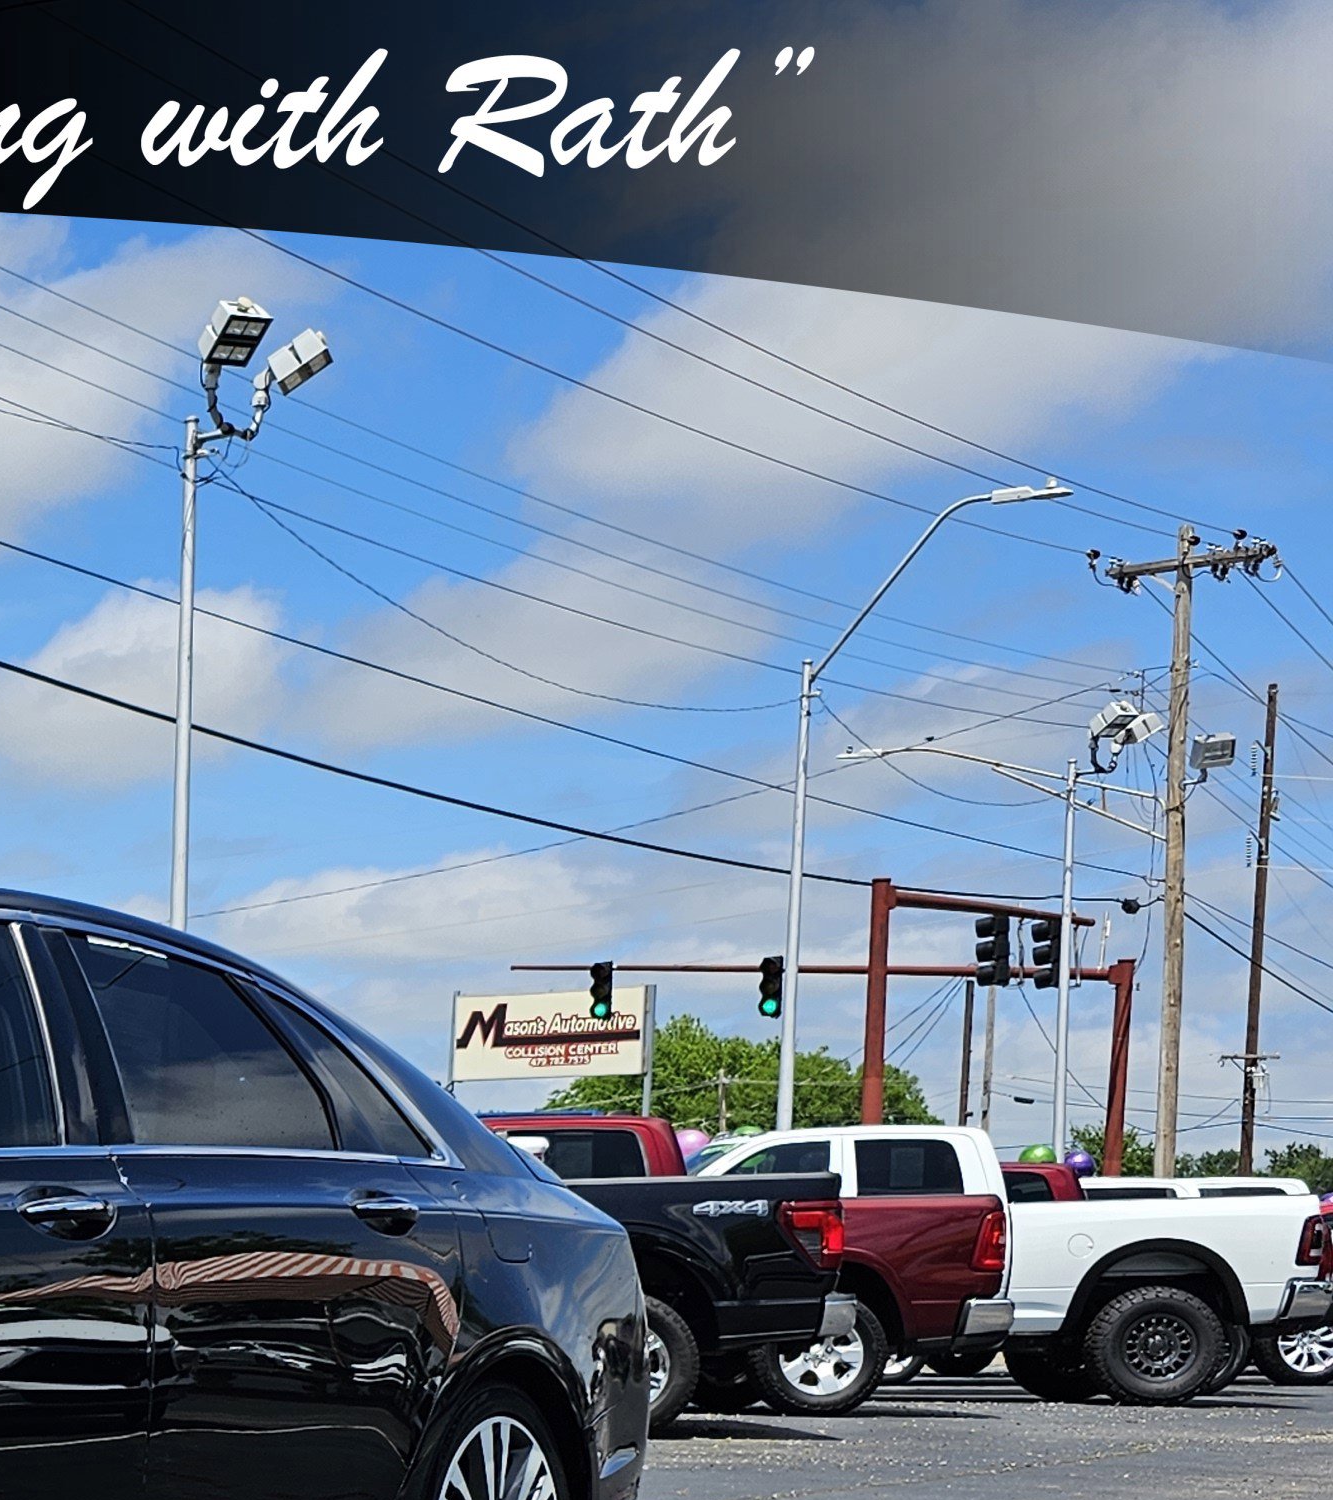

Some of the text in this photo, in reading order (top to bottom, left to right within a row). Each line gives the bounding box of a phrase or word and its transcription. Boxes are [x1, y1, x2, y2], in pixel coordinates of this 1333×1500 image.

[456, 1003, 547, 1049] Mason's
[504, 1042, 619, 1059] COLLISION CENTER
